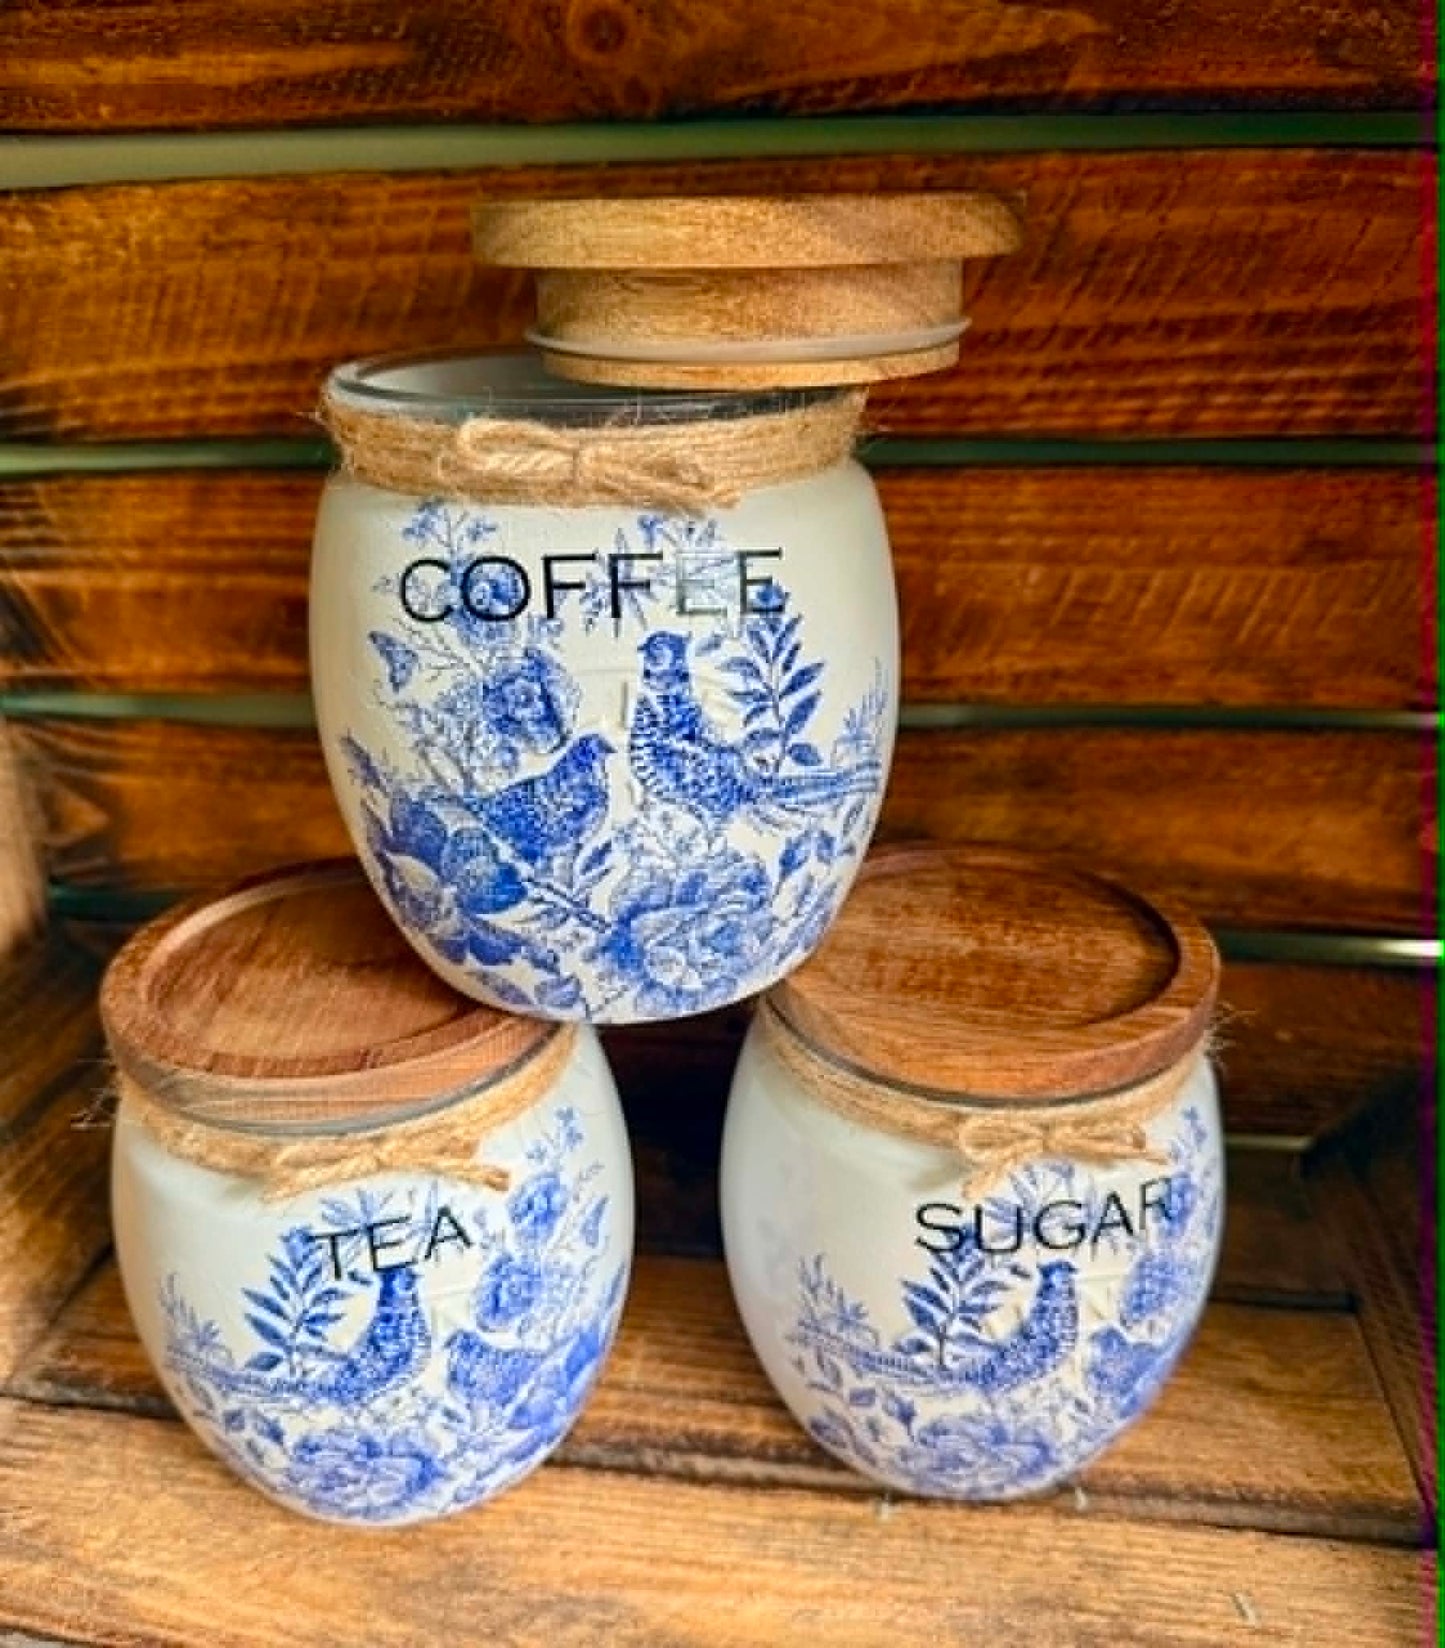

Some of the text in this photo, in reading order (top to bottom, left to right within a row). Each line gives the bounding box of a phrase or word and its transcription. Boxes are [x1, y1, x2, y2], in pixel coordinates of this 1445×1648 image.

[401, 547, 785, 622] COFFEE
[308, 1205, 472, 1280] TEA
[914, 1177, 1172, 1254] SUGAR
